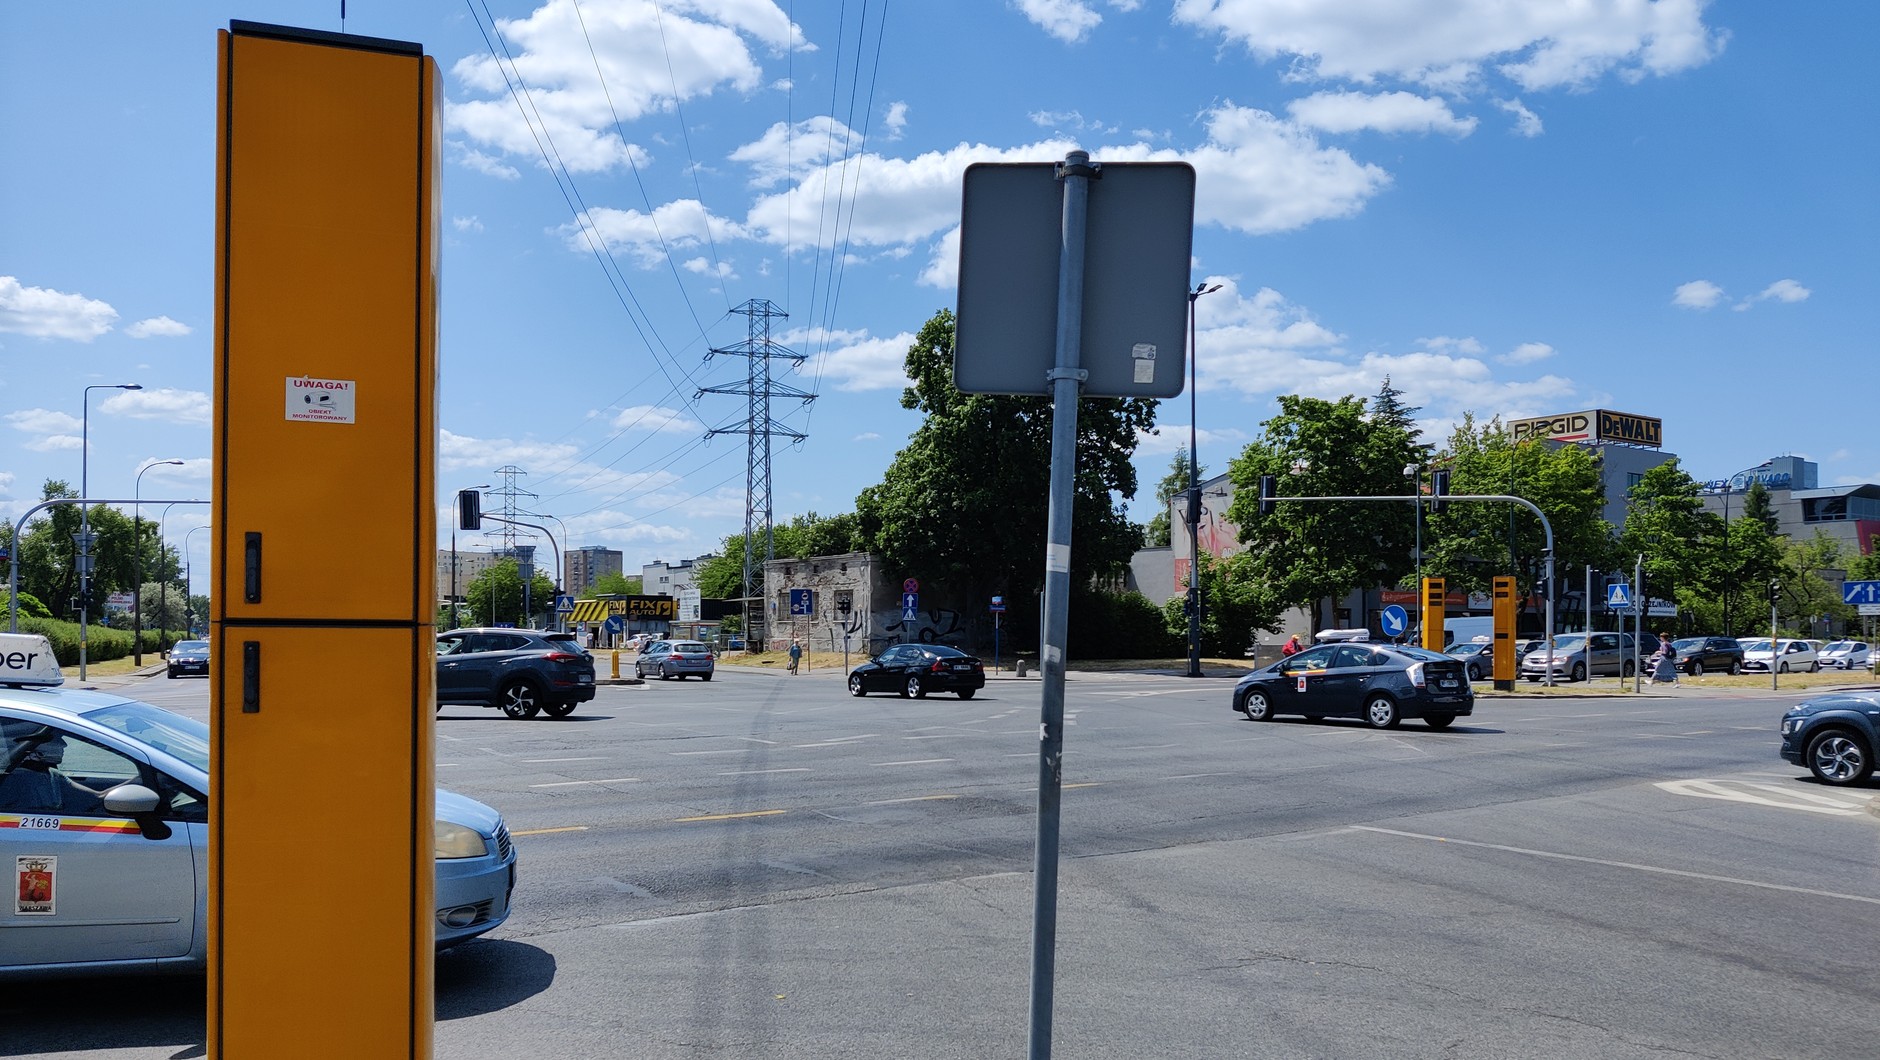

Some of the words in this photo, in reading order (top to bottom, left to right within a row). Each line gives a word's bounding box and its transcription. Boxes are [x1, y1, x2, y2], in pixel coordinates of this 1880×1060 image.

[294, 380, 348, 390] UWAGA!
[292, 413, 347, 421] MONITOROWANY
[1515, 415, 1589, 439] RIDGID
[609, 600, 621, 609] FIX
[630, 600, 656, 609] FIX
[21, 818, 59, 829] 21669
